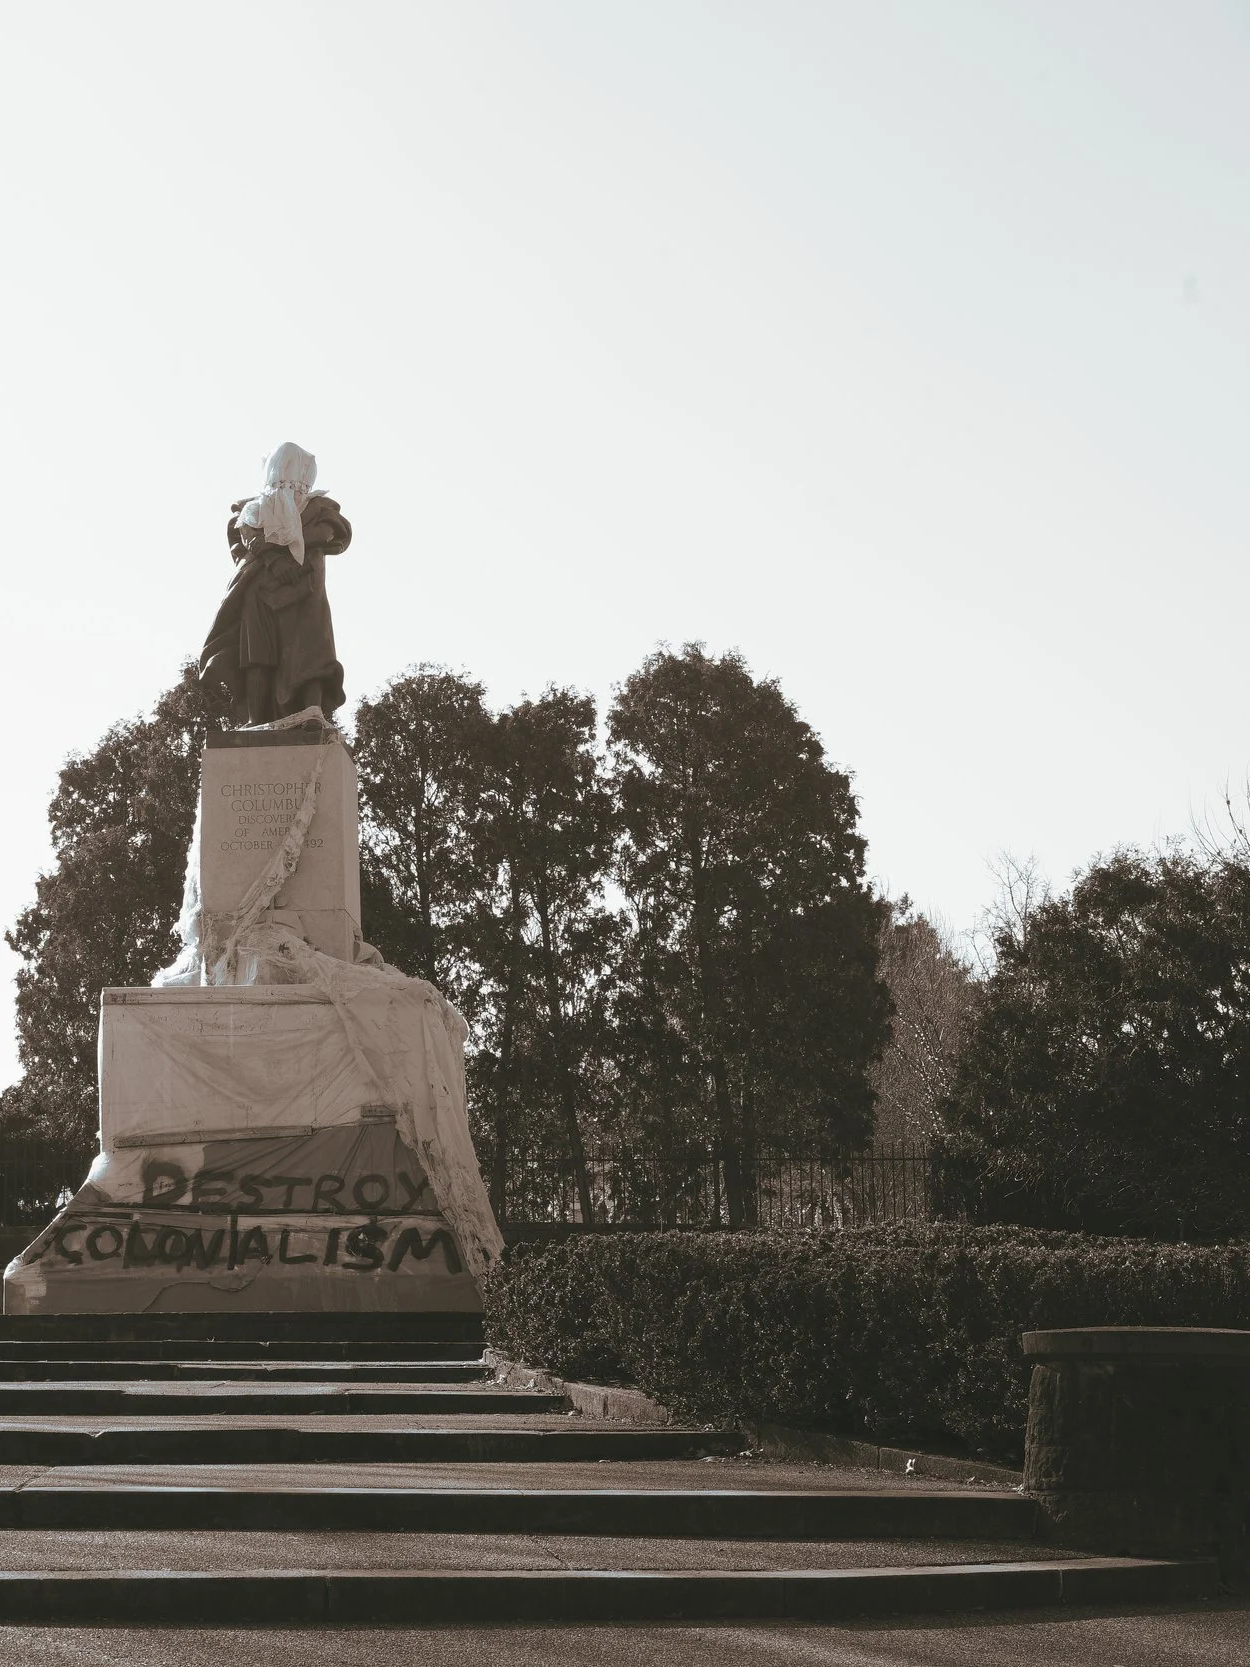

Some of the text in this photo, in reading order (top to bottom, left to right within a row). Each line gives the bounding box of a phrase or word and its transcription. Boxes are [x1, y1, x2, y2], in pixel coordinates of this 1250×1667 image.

[231, 798, 300, 812] COLUMBU
[235, 828, 249, 838] OF
[221, 838, 324, 851] OCTOBER 492
[141, 1158, 433, 1211] DESTROY
[55, 1214, 462, 1273] COLONIALISM
